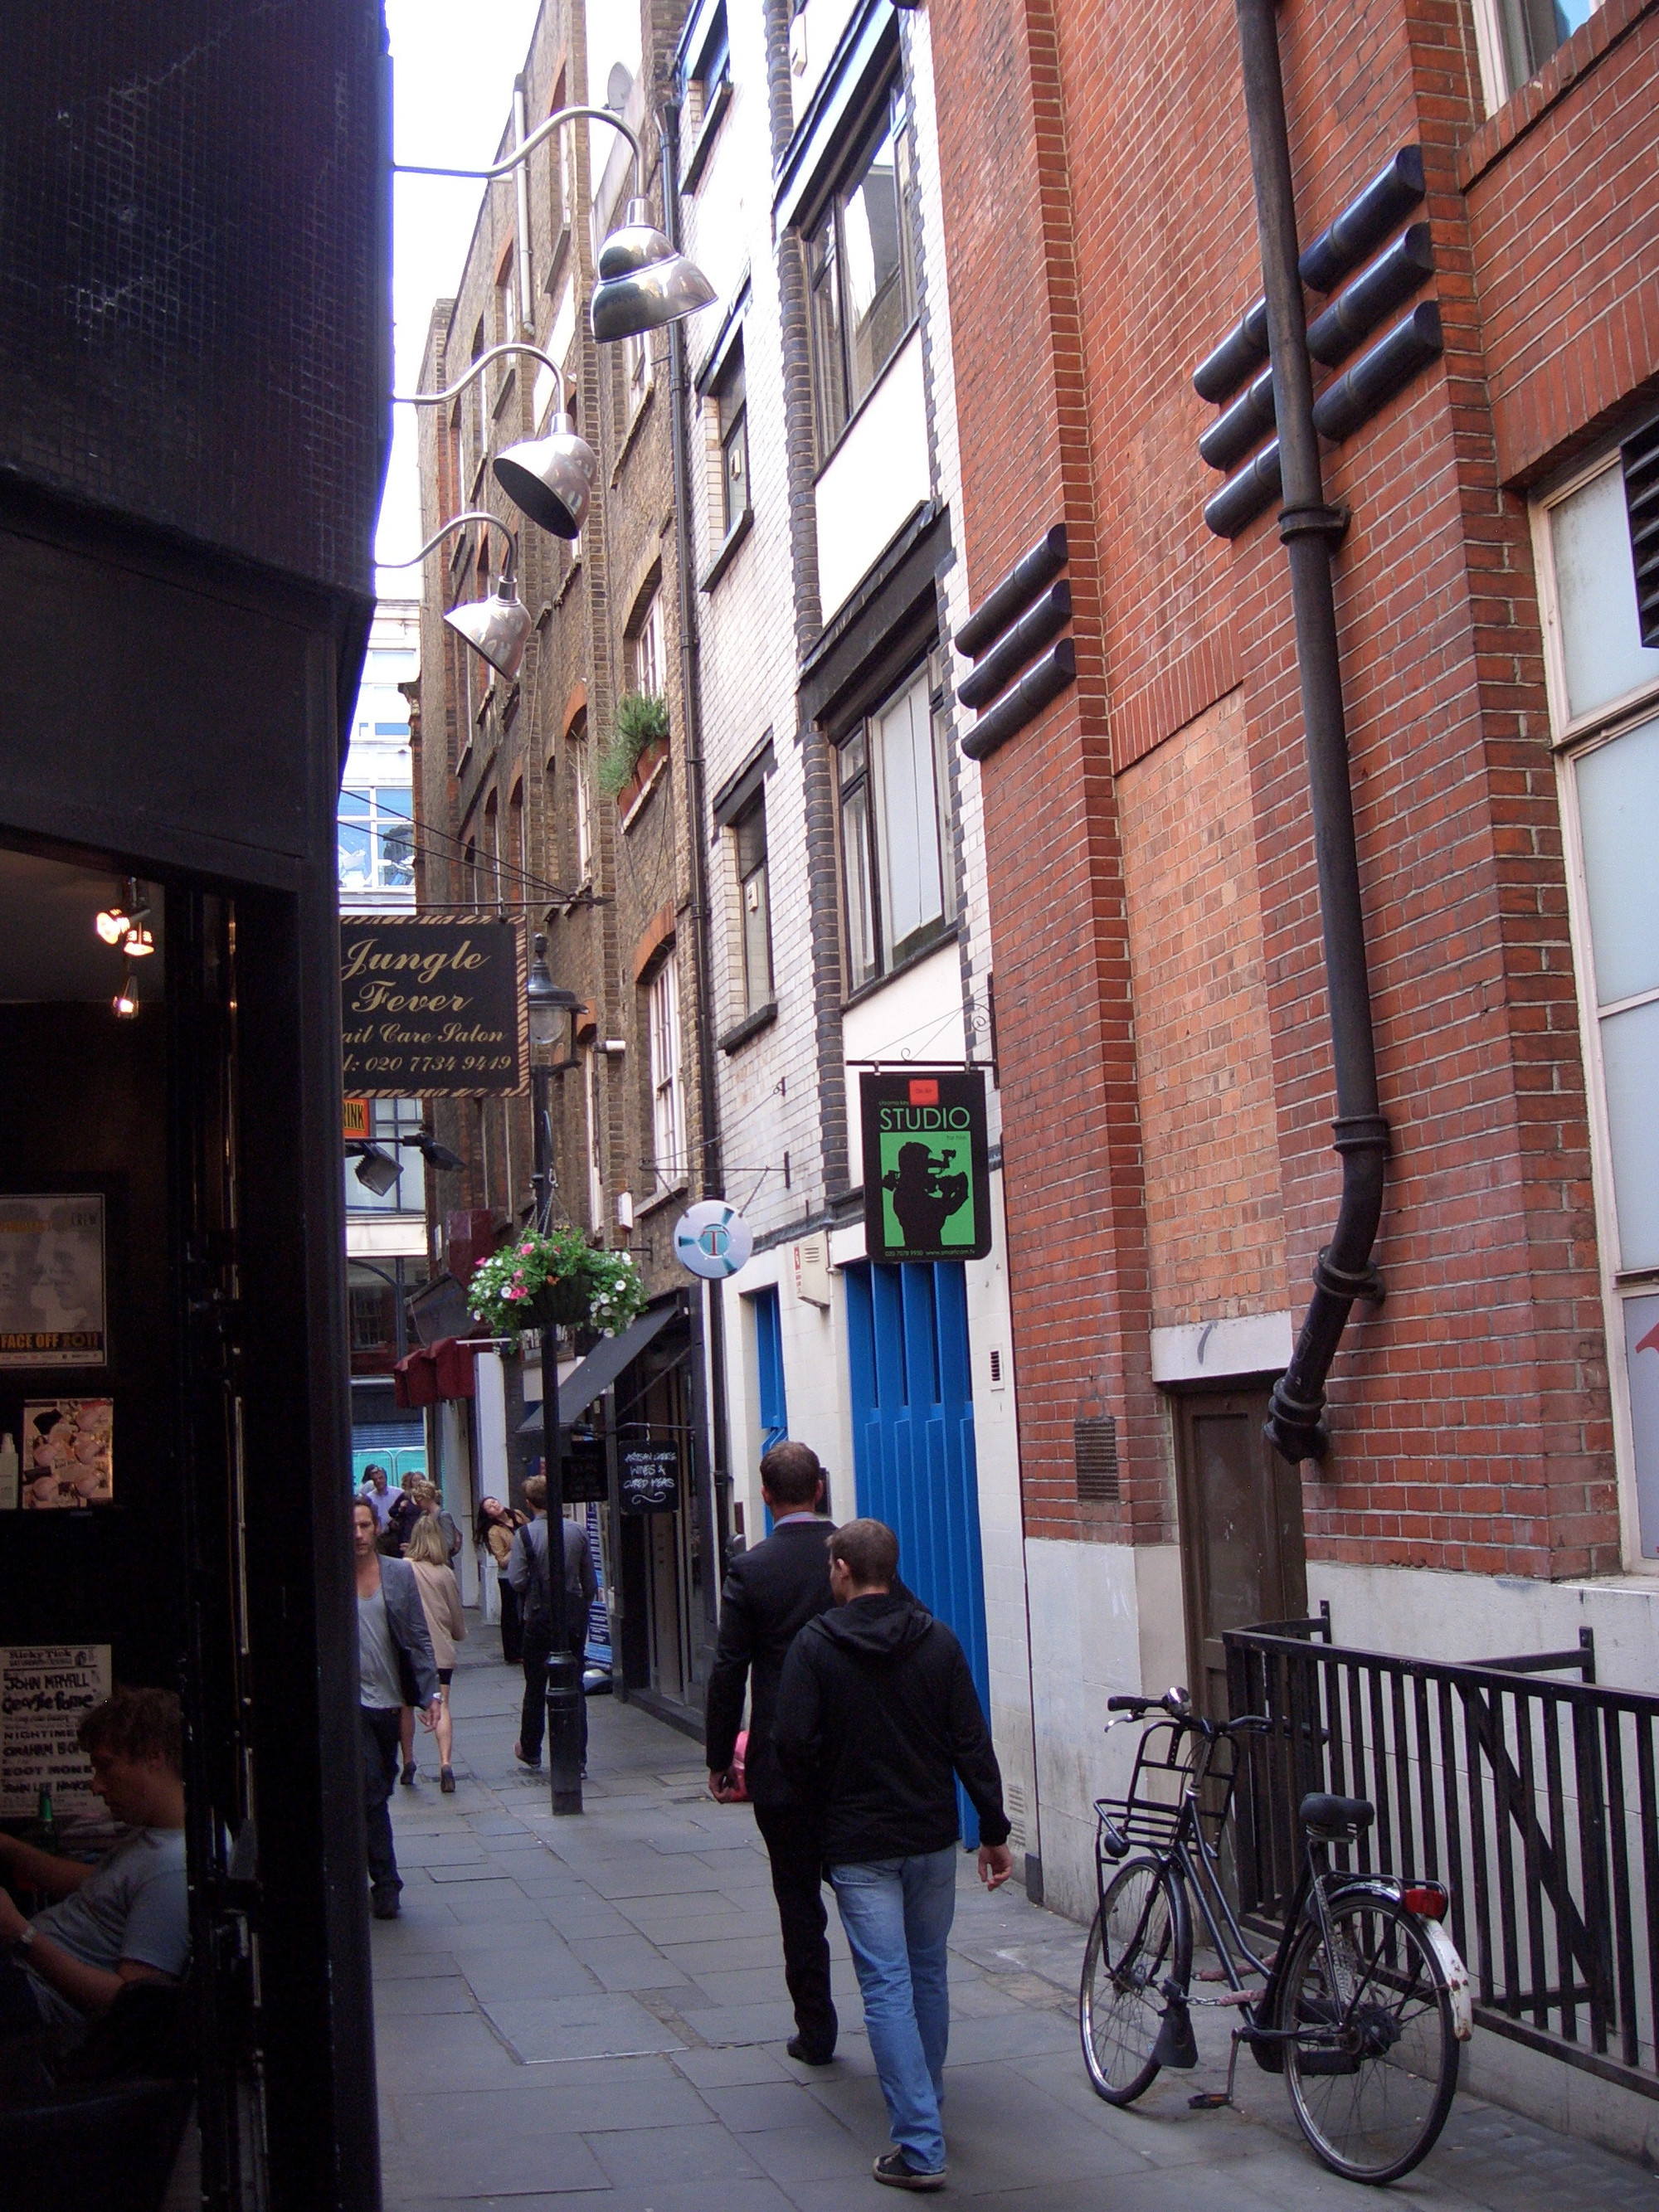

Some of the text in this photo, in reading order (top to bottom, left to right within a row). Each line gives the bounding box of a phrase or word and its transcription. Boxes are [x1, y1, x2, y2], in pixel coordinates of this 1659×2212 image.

[341, 938, 491, 984] Jungle
[352, 980, 474, 1012] Fever
[342, 1023, 508, 1043] ail Care Salon
[365, 1056, 403, 1072] 020
[410, 1056, 456, 1072] 7734
[461, 1056, 512, 1071] 9419
[879, 1106, 971, 1130] STUDIO
[1, 1333, 33, 1349] FACE
[35, 1332, 59, 1349] OFF
[4, 1673, 90, 1690] JOHN MAYALL
